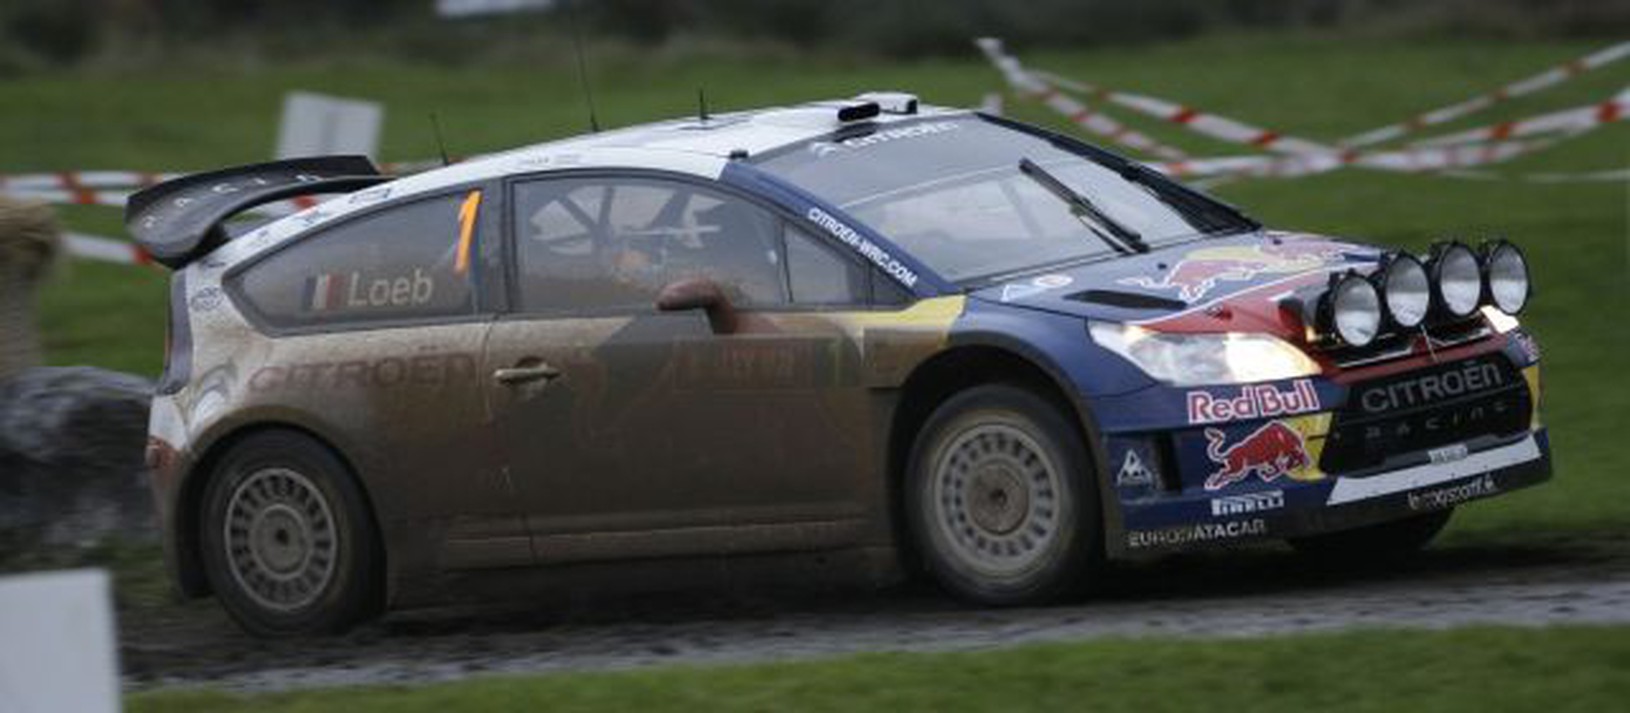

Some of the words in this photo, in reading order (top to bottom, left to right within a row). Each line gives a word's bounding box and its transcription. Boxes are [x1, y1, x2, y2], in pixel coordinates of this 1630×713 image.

[455, 190, 483, 275] 1
[348, 266, 434, 306] Loeb
[1187, 385, 1258, 425] Red
[1256, 379, 1321, 416] Bull
[1211, 489, 1284, 516] PIRELLI
